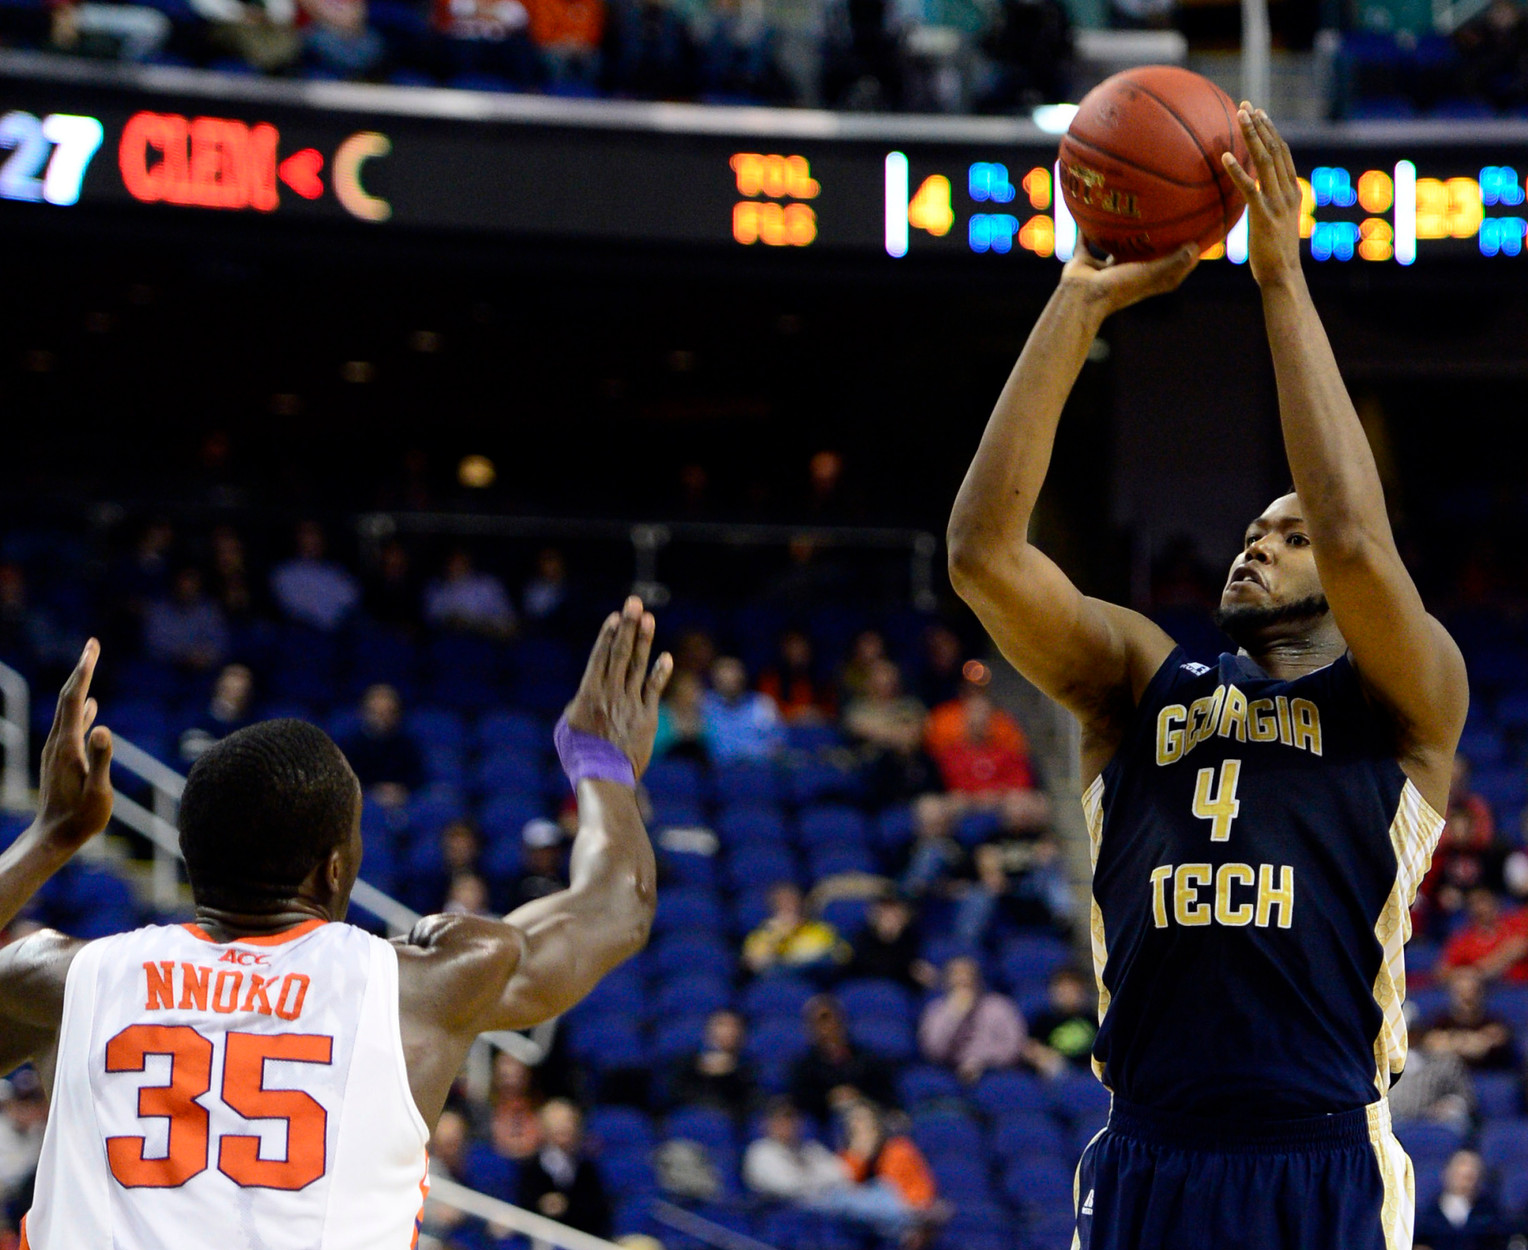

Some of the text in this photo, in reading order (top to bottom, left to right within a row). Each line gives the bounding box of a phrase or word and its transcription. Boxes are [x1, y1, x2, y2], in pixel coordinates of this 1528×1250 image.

[1156, 683, 1323, 767] GEORGIA
[1192, 759, 1242, 842] 4
[1150, 862, 1294, 929] TECH
[142, 960, 311, 1021] NNOKO
[218, 948, 272, 966] ACC
[105, 1023, 333, 1191] 35
